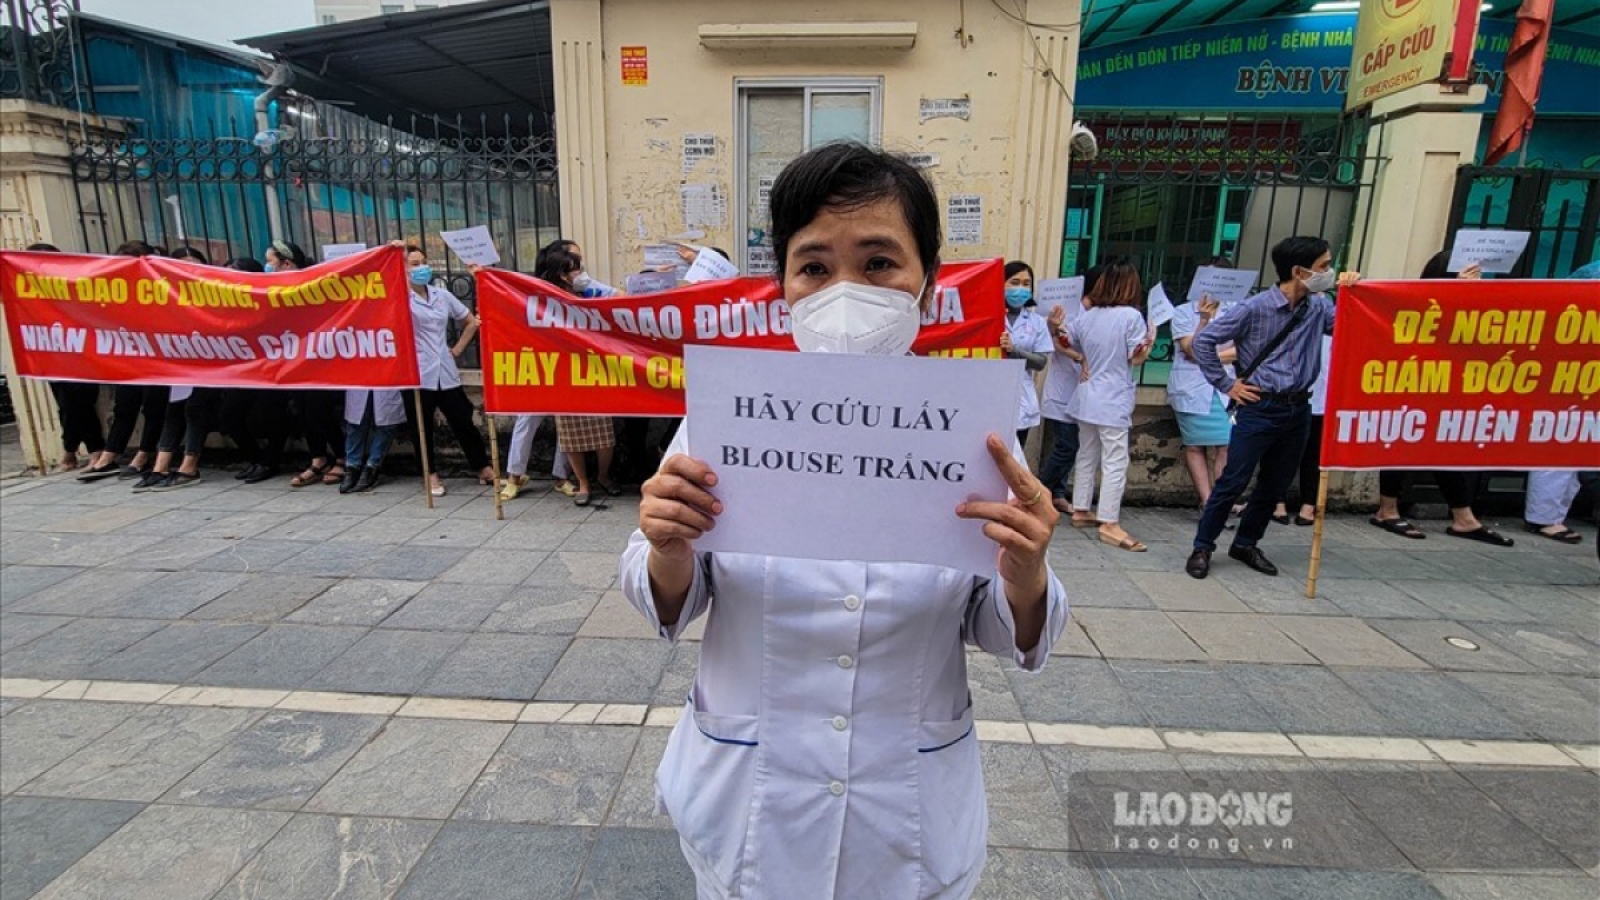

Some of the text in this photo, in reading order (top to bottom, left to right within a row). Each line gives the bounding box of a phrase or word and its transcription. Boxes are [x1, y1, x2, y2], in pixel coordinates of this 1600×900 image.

[1171, 40, 1201, 61] TIẾP
[1281, 29, 1321, 53] BỆNH
[1363, 24, 1436, 75] CẤP CỨU
[1235, 58, 1316, 99] BỆNH
[1363, 67, 1422, 98] EMERGENCY
[76, 276, 129, 308] ĐẠO
[136, 276, 170, 306] CÓ
[20, 321, 398, 361] NHÂN VIÊN KHÔNG CÓ LƯƠNG
[1393, 298, 1442, 344] ĐỀ
[1448, 310, 1548, 351] NGHỊ
[492, 346, 560, 387] HÃY
[571, 348, 637, 387] LÀM
[1361, 350, 1600, 401] GIÁM ĐỐC HỌ
[733, 392, 960, 432] HÃY CỨU LẤY
[1336, 404, 1427, 449] THỰC
[1436, 404, 1519, 449] HIỆN
[720, 445, 966, 484] BLOUSE TRẮNG
